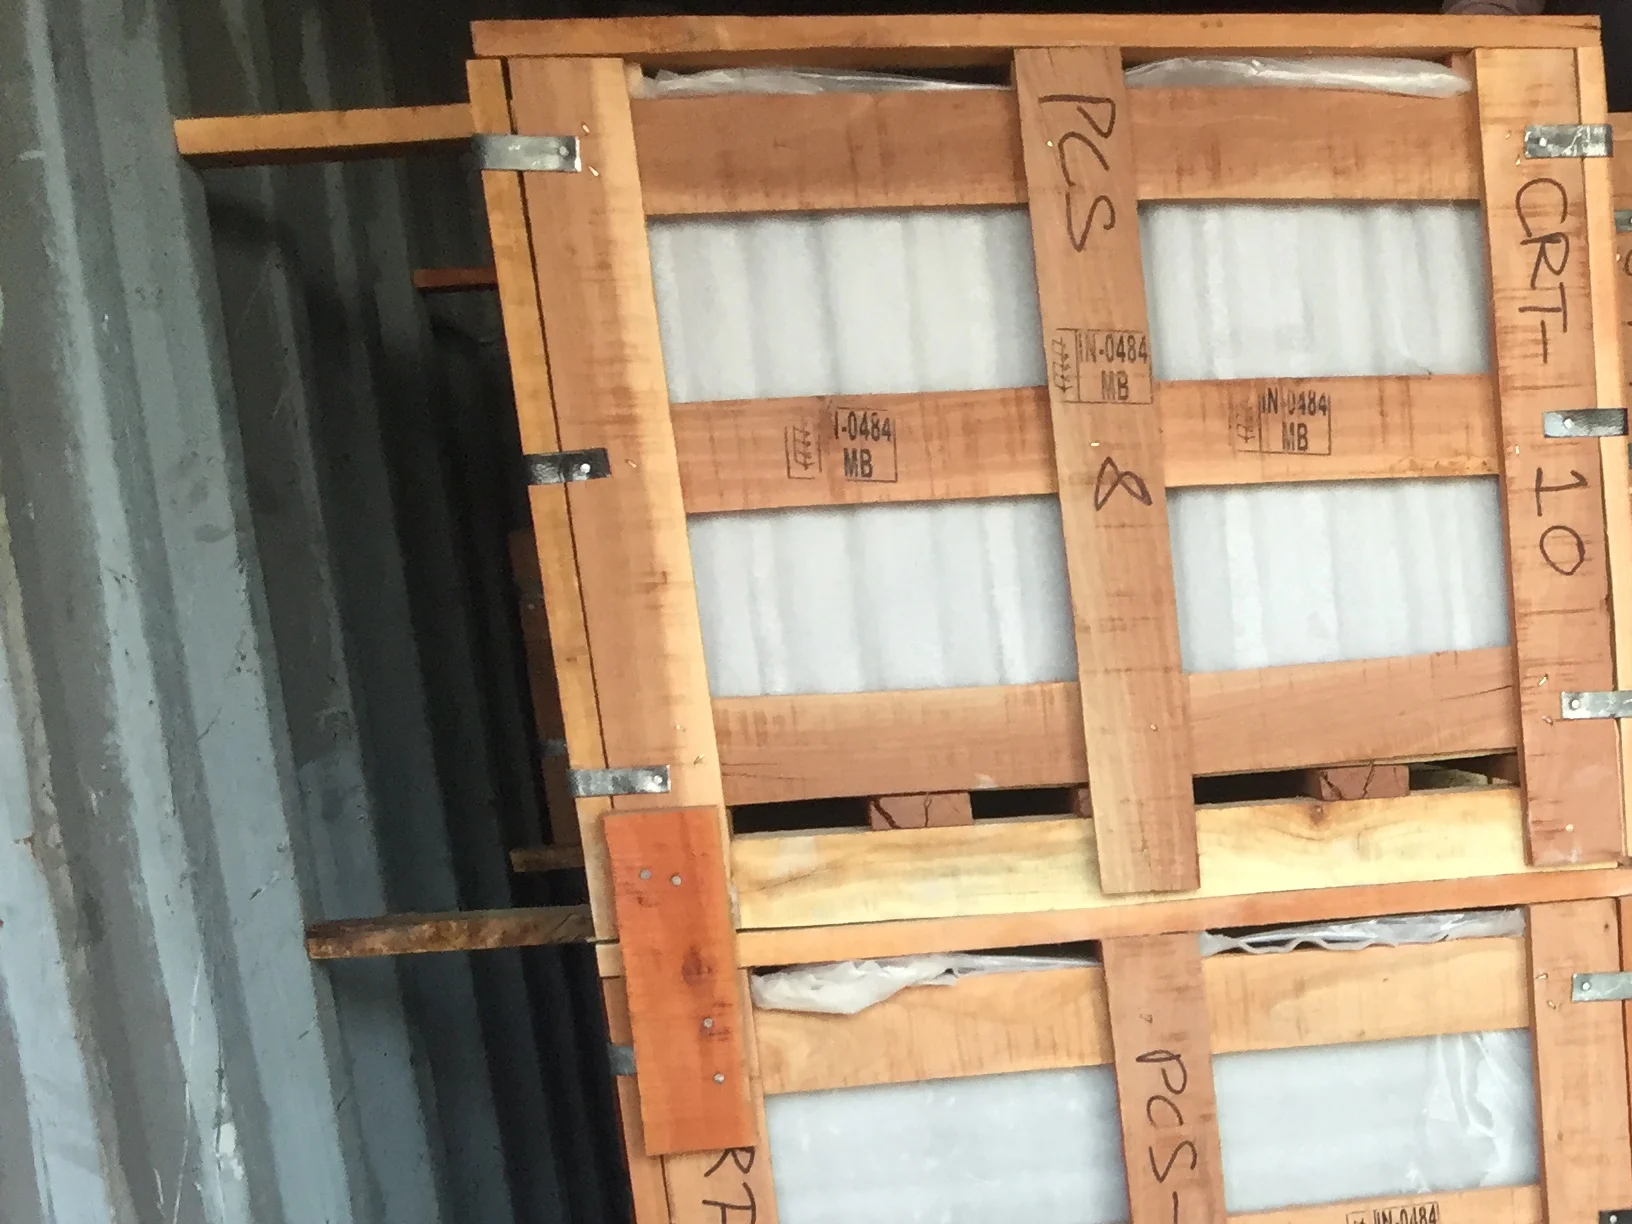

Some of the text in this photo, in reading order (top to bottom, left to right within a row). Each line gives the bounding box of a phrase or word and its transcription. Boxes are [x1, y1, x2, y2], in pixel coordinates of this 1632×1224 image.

[1038, 95, 1153, 510] PCS 8
[1101, 370, 1129, 401] MB
[1281, 421, 1308, 451] MB
[843, 447, 873, 478] MB
[1534, 468, 1588, 575] 10
